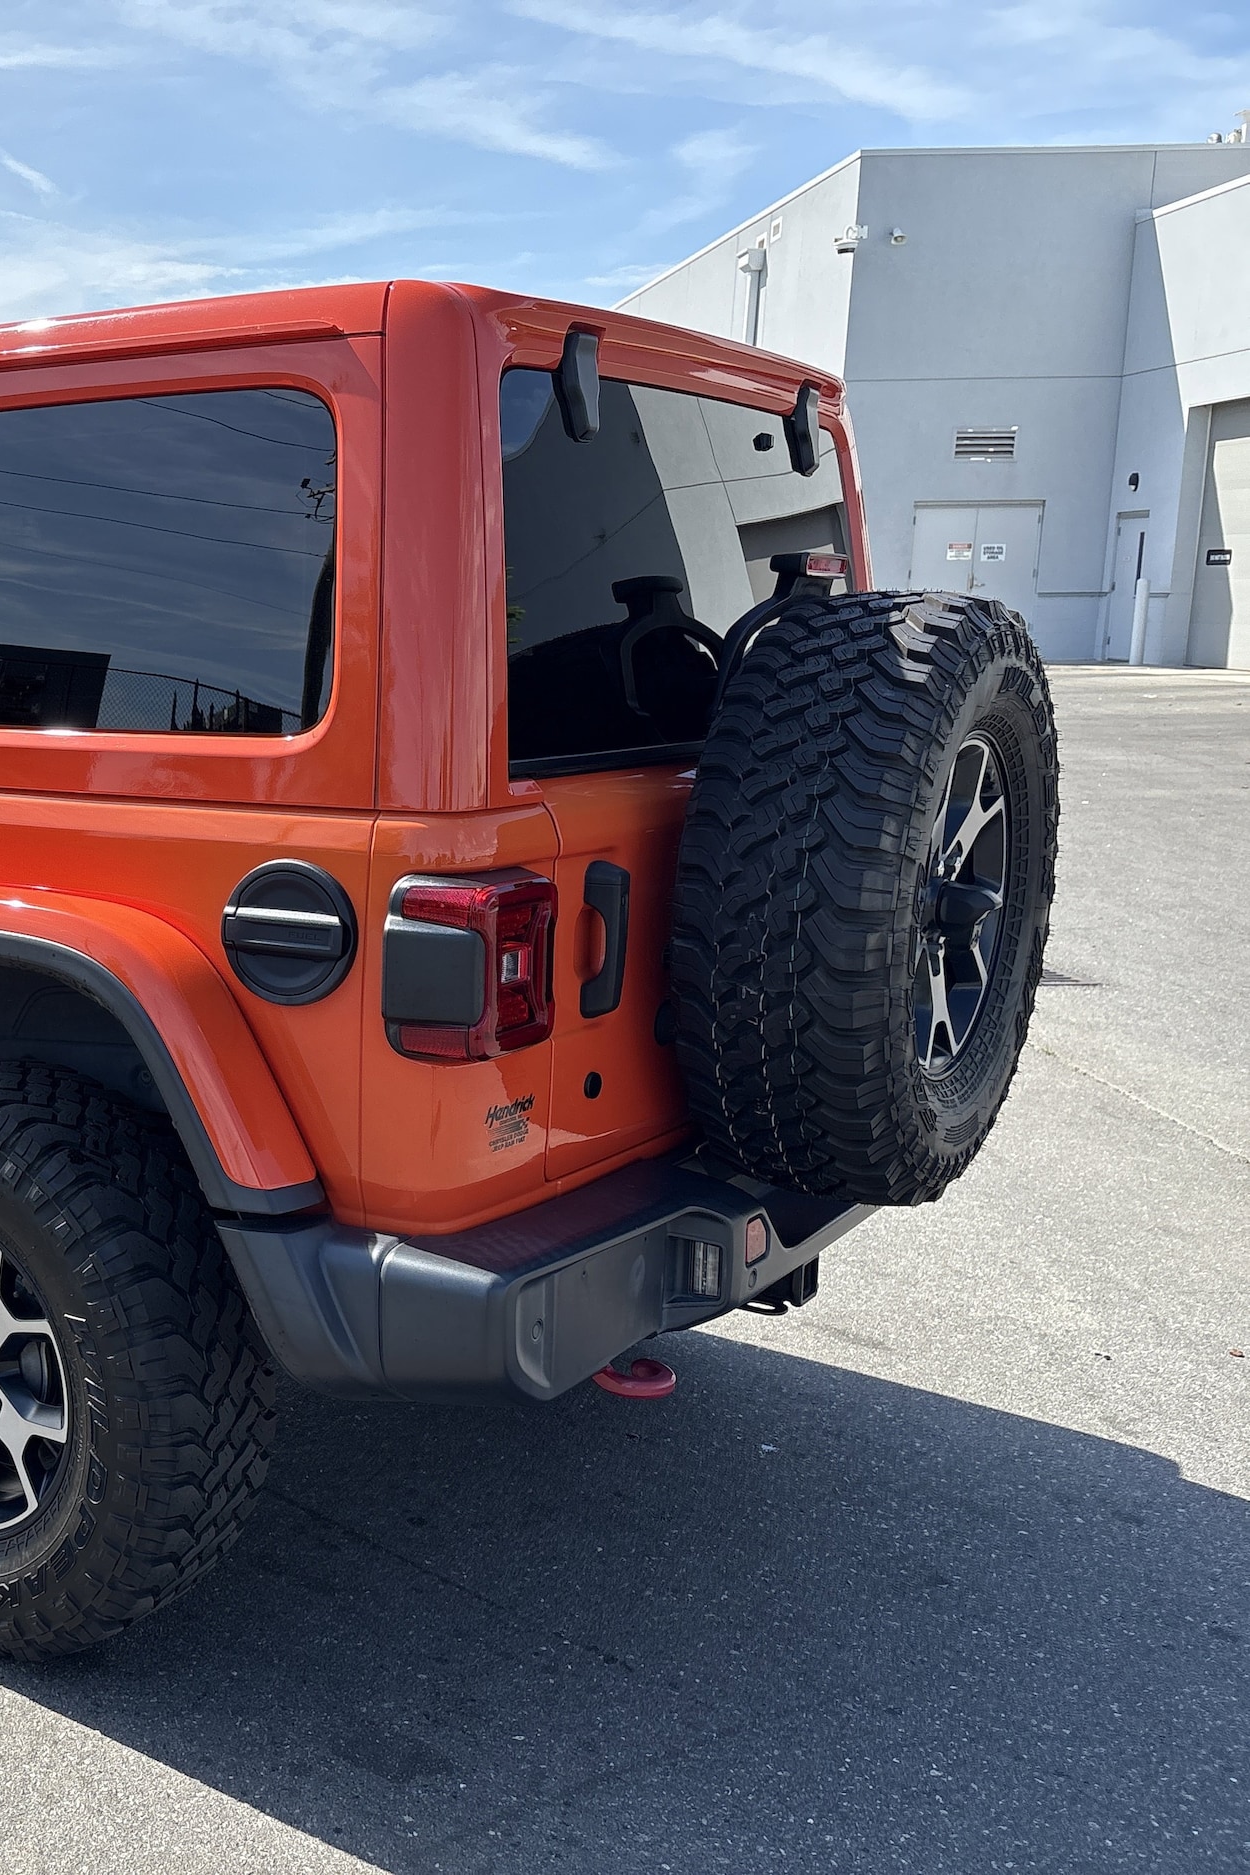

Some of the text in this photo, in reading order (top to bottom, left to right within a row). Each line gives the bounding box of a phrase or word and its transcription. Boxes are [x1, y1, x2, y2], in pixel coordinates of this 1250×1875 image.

[288, 931, 321, 941] FUEL
[484, 1093, 535, 1128] Hendrick
[489, 1128, 529, 1147] CHRYSLER DODGE
[492, 1135, 526, 1152] JEEP RAM FIAT
